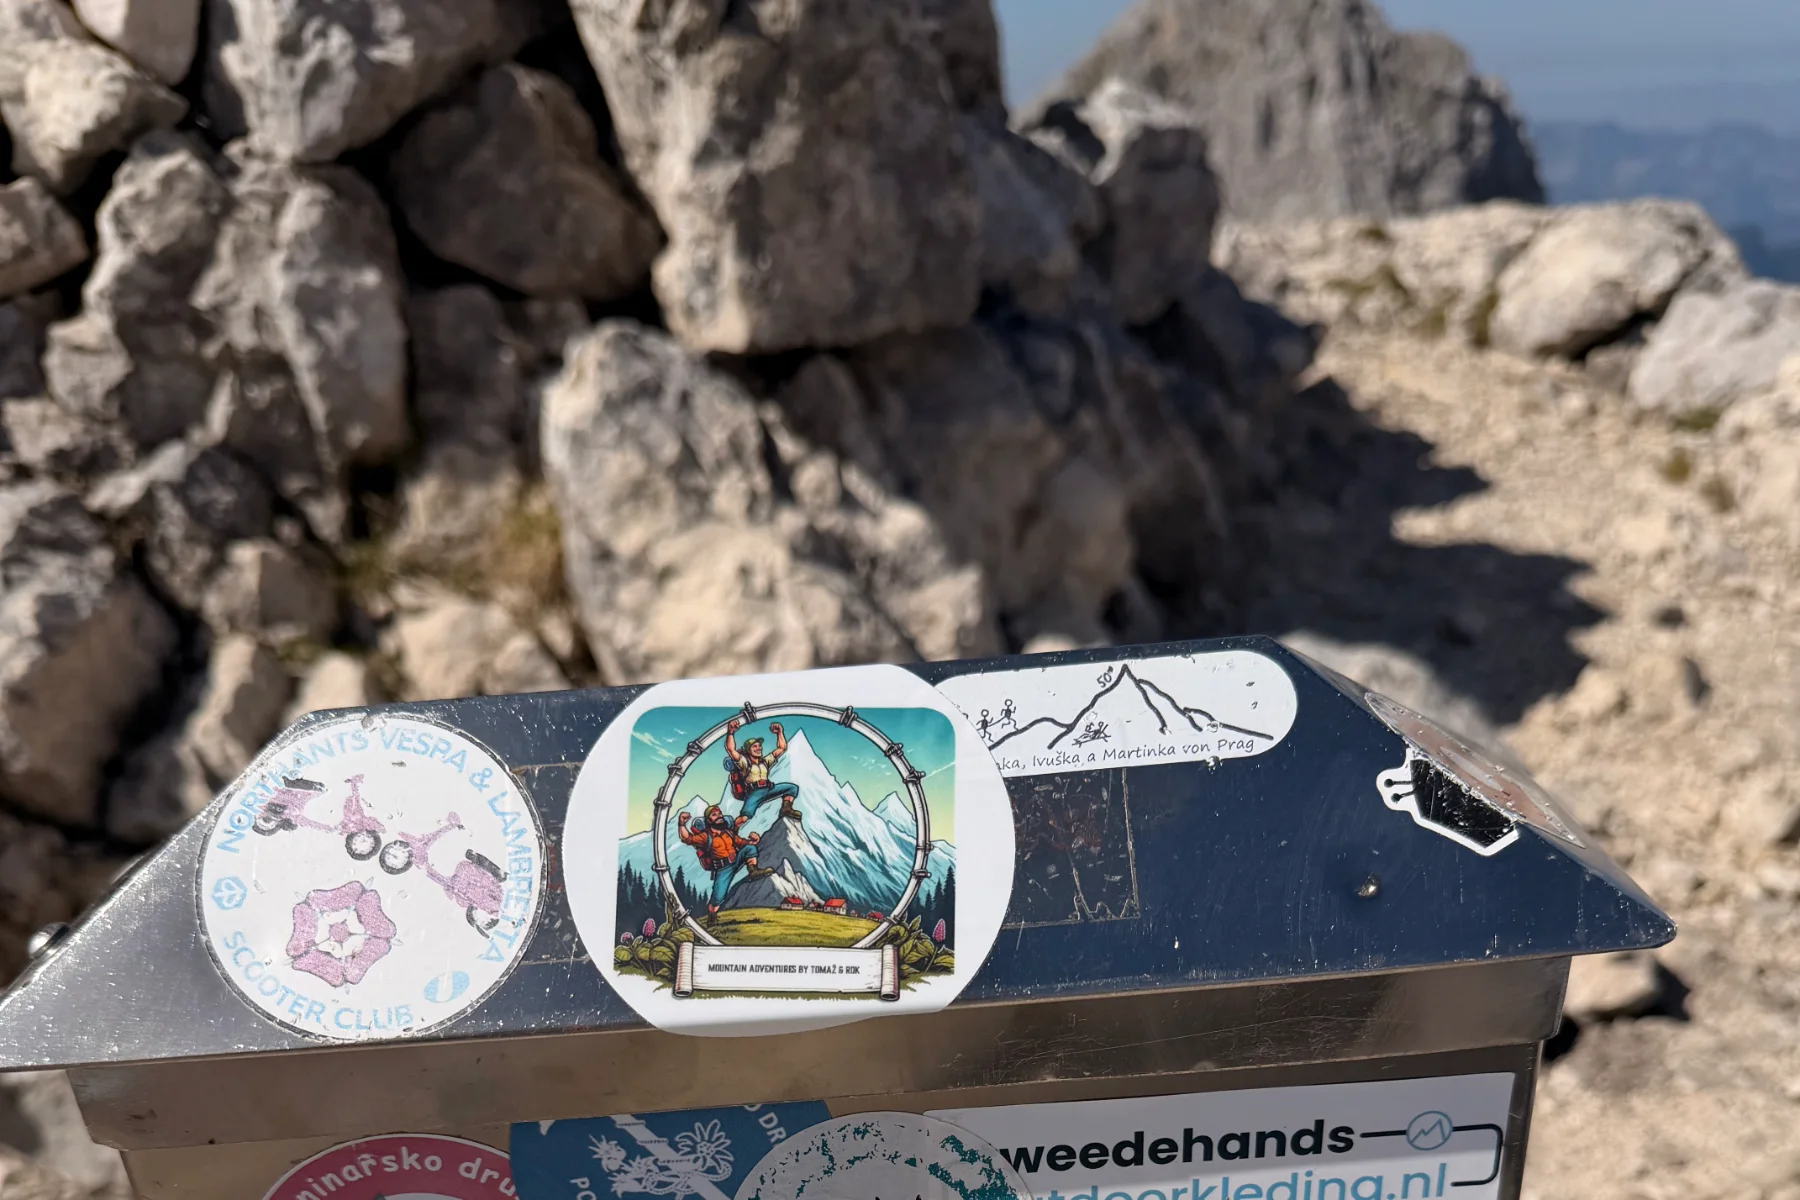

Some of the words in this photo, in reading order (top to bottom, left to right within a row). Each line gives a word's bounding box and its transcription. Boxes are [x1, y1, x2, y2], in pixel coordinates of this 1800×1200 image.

[380, 727, 469, 774] VESPA
[1032, 751, 1081, 767] Ivuška
[1087, 752, 1096, 762] a
[1102, 744, 1177, 762] Martinka
[1182, 742, 1212, 754] von
[1217, 738, 1256, 754] Prag
[216, 730, 370, 854] NORTHANTS
[468, 766, 497, 794] &
[477, 790, 534, 964] LAMBRETTA
[223, 930, 328, 1024] SCOOTER
[334, 1004, 415, 1030] CLUB
[708, 963, 748, 973] MOUNTAIN
[749, 964, 797, 974] ADVENTURES
[798, 965, 808, 974] BY
[811, 964, 837, 975] TOMAŽ
[846, 965, 860, 975] ROK
[757, 1111, 787, 1145] DR
